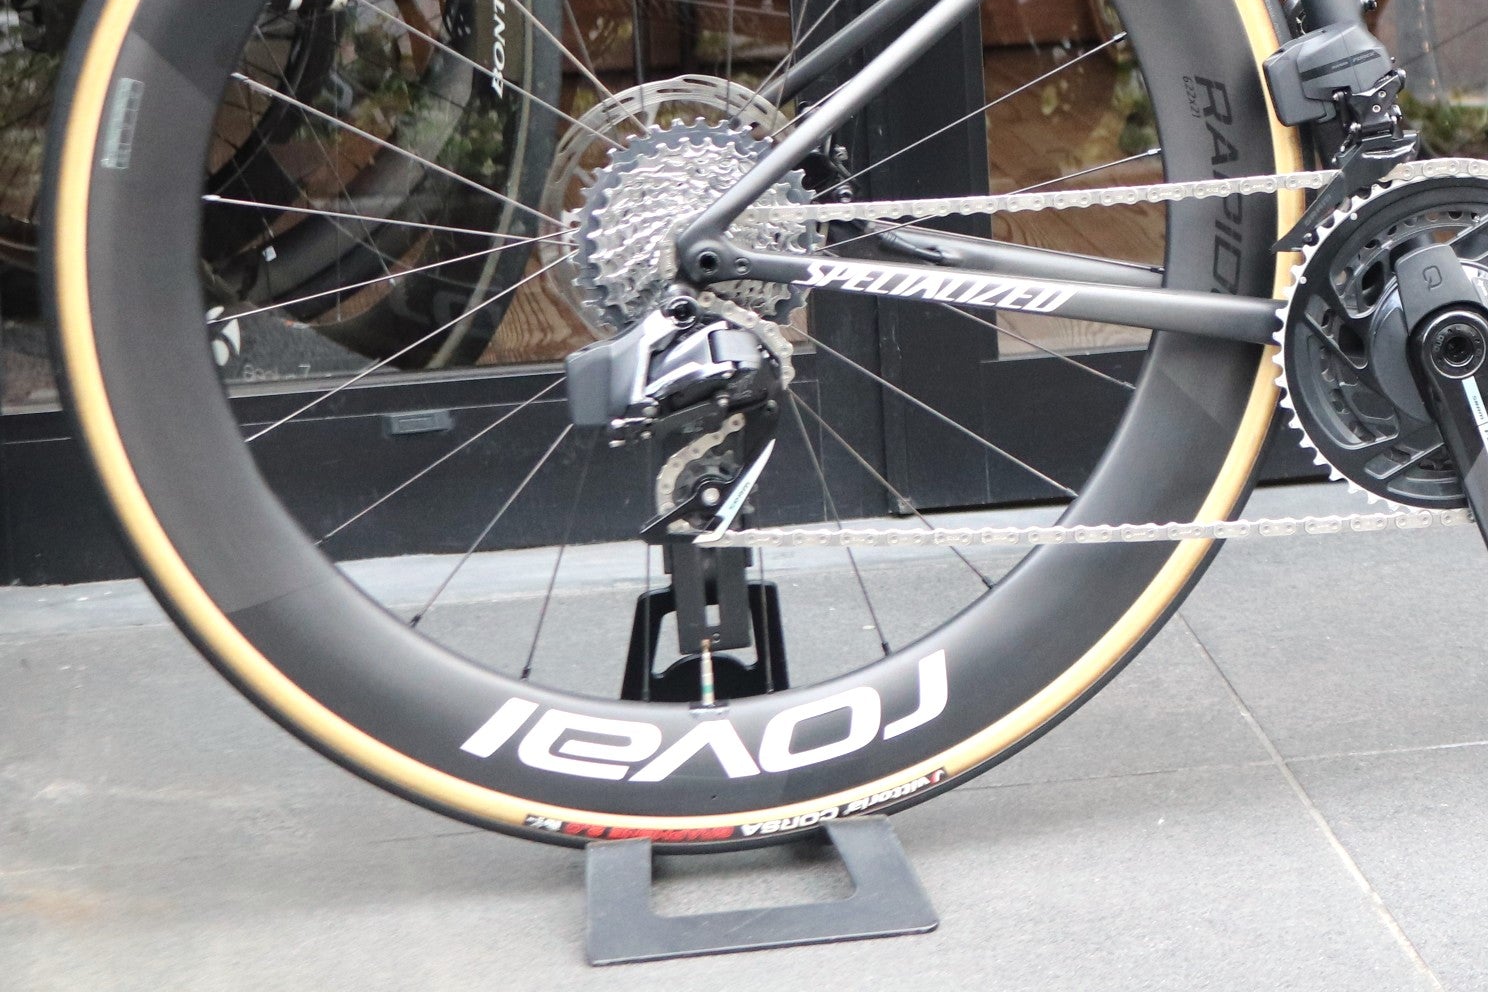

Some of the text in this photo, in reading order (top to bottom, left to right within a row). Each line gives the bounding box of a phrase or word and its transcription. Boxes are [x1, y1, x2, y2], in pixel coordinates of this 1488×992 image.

[1194, 75, 1243, 295] RAPID
[792, 261, 1080, 312] SPECIALIZED
[459, 648, 949, 782] roval
[740, 805, 840, 837] CORSA
